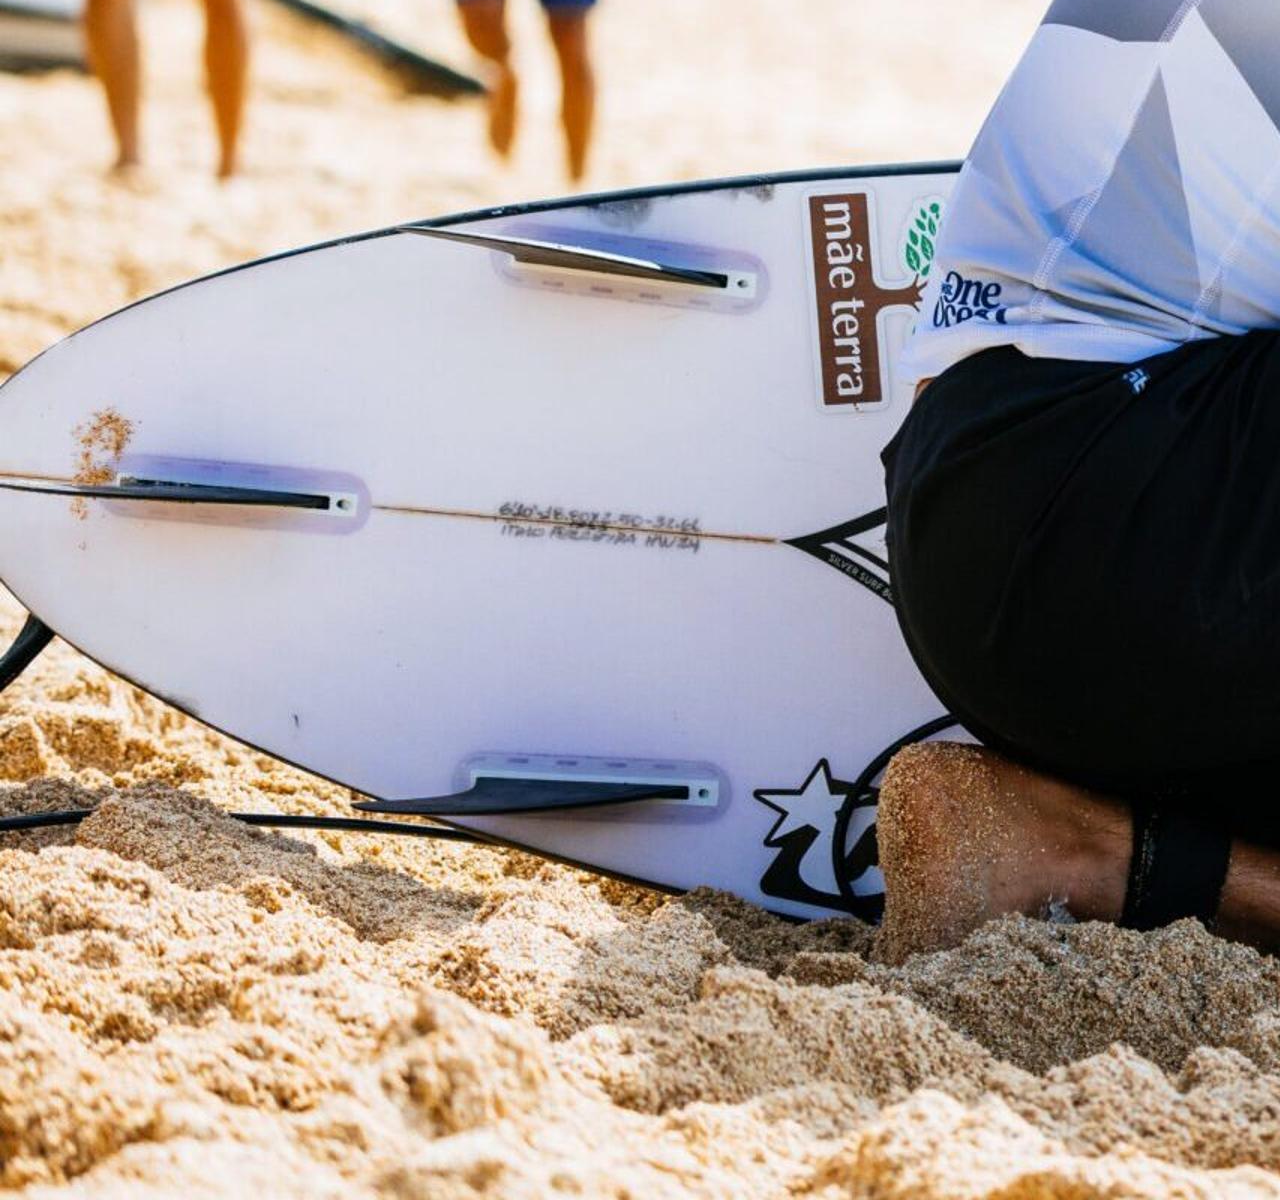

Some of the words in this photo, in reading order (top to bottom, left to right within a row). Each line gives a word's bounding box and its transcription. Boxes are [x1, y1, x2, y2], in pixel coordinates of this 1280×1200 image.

[822, 202, 863, 290] mãe
[942, 269, 1003, 309] One
[829, 297, 866, 397] terra
[828, 553, 860, 575] SILVER
[860, 569, 884, 591] SURF
